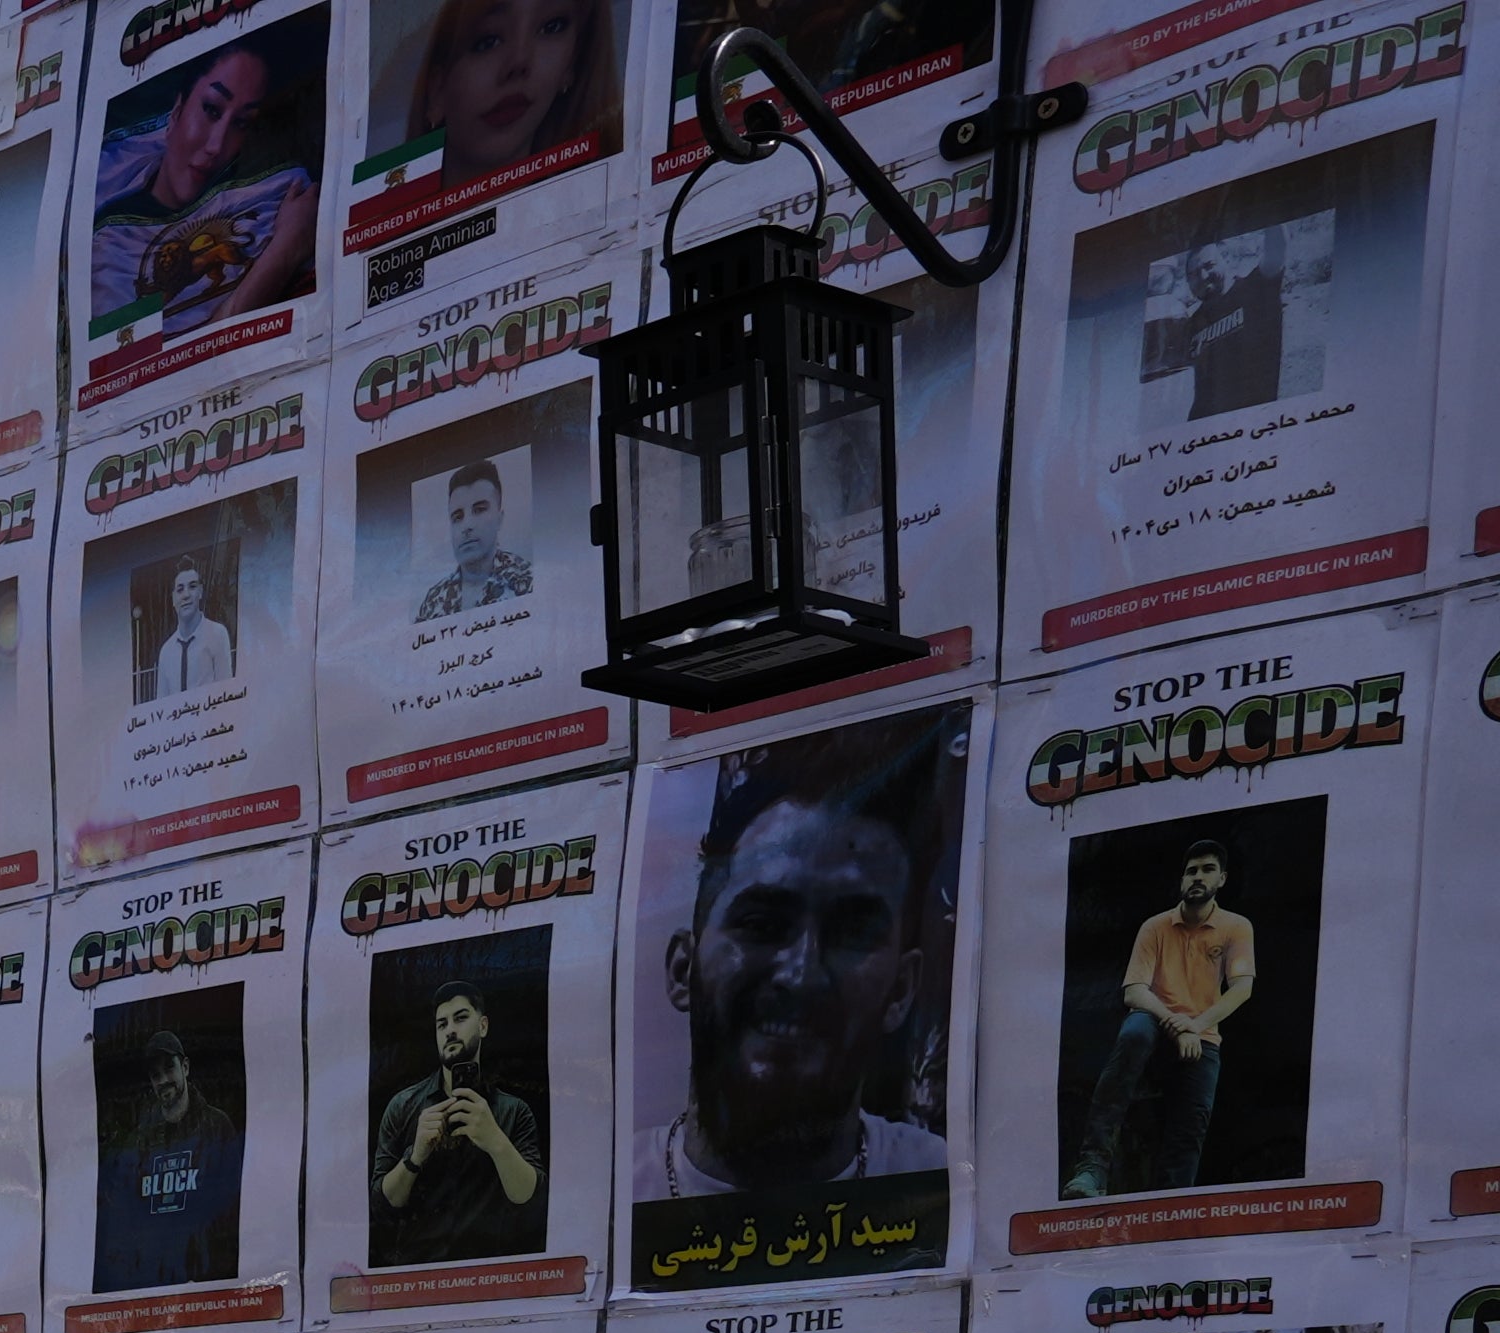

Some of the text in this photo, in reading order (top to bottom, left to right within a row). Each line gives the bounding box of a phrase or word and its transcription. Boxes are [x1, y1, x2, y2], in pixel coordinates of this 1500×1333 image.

[1072, 1, 1467, 194] GENOCIDE
[368, 216, 496, 276] Robina Aminian
[368, 267, 423, 304] Age 23
[417, 276, 537, 338] STOP THE
[353, 281, 612, 423] GENOCIDE
[139, 386, 242, 439] STOP THE
[1250, 412, 1298, 441] حاجی
[1304, 400, 1355, 424] محمد
[85, 393, 305, 515] GENOCIDE
[1108, 450, 1141, 474] سال
[1147, 439, 1172, 461] ۳۷
[1163, 470, 1213, 497] تهران
[1070, 546, 1394, 628] MURDERED BY THE ISLAMIC REPUBLIC IN IRAN
[1113, 655, 1294, 712] STOP THE
[1026, 671, 1405, 807] GENOCIDE
[121, 880, 224, 921] STOP THE
[70, 896, 285, 991] GENOCIDE
[141, 1167, 199, 1199] BLOCK
[651, 1201, 917, 1277] سید آرش قریشی
[786, 1308, 844, 1333] THE
